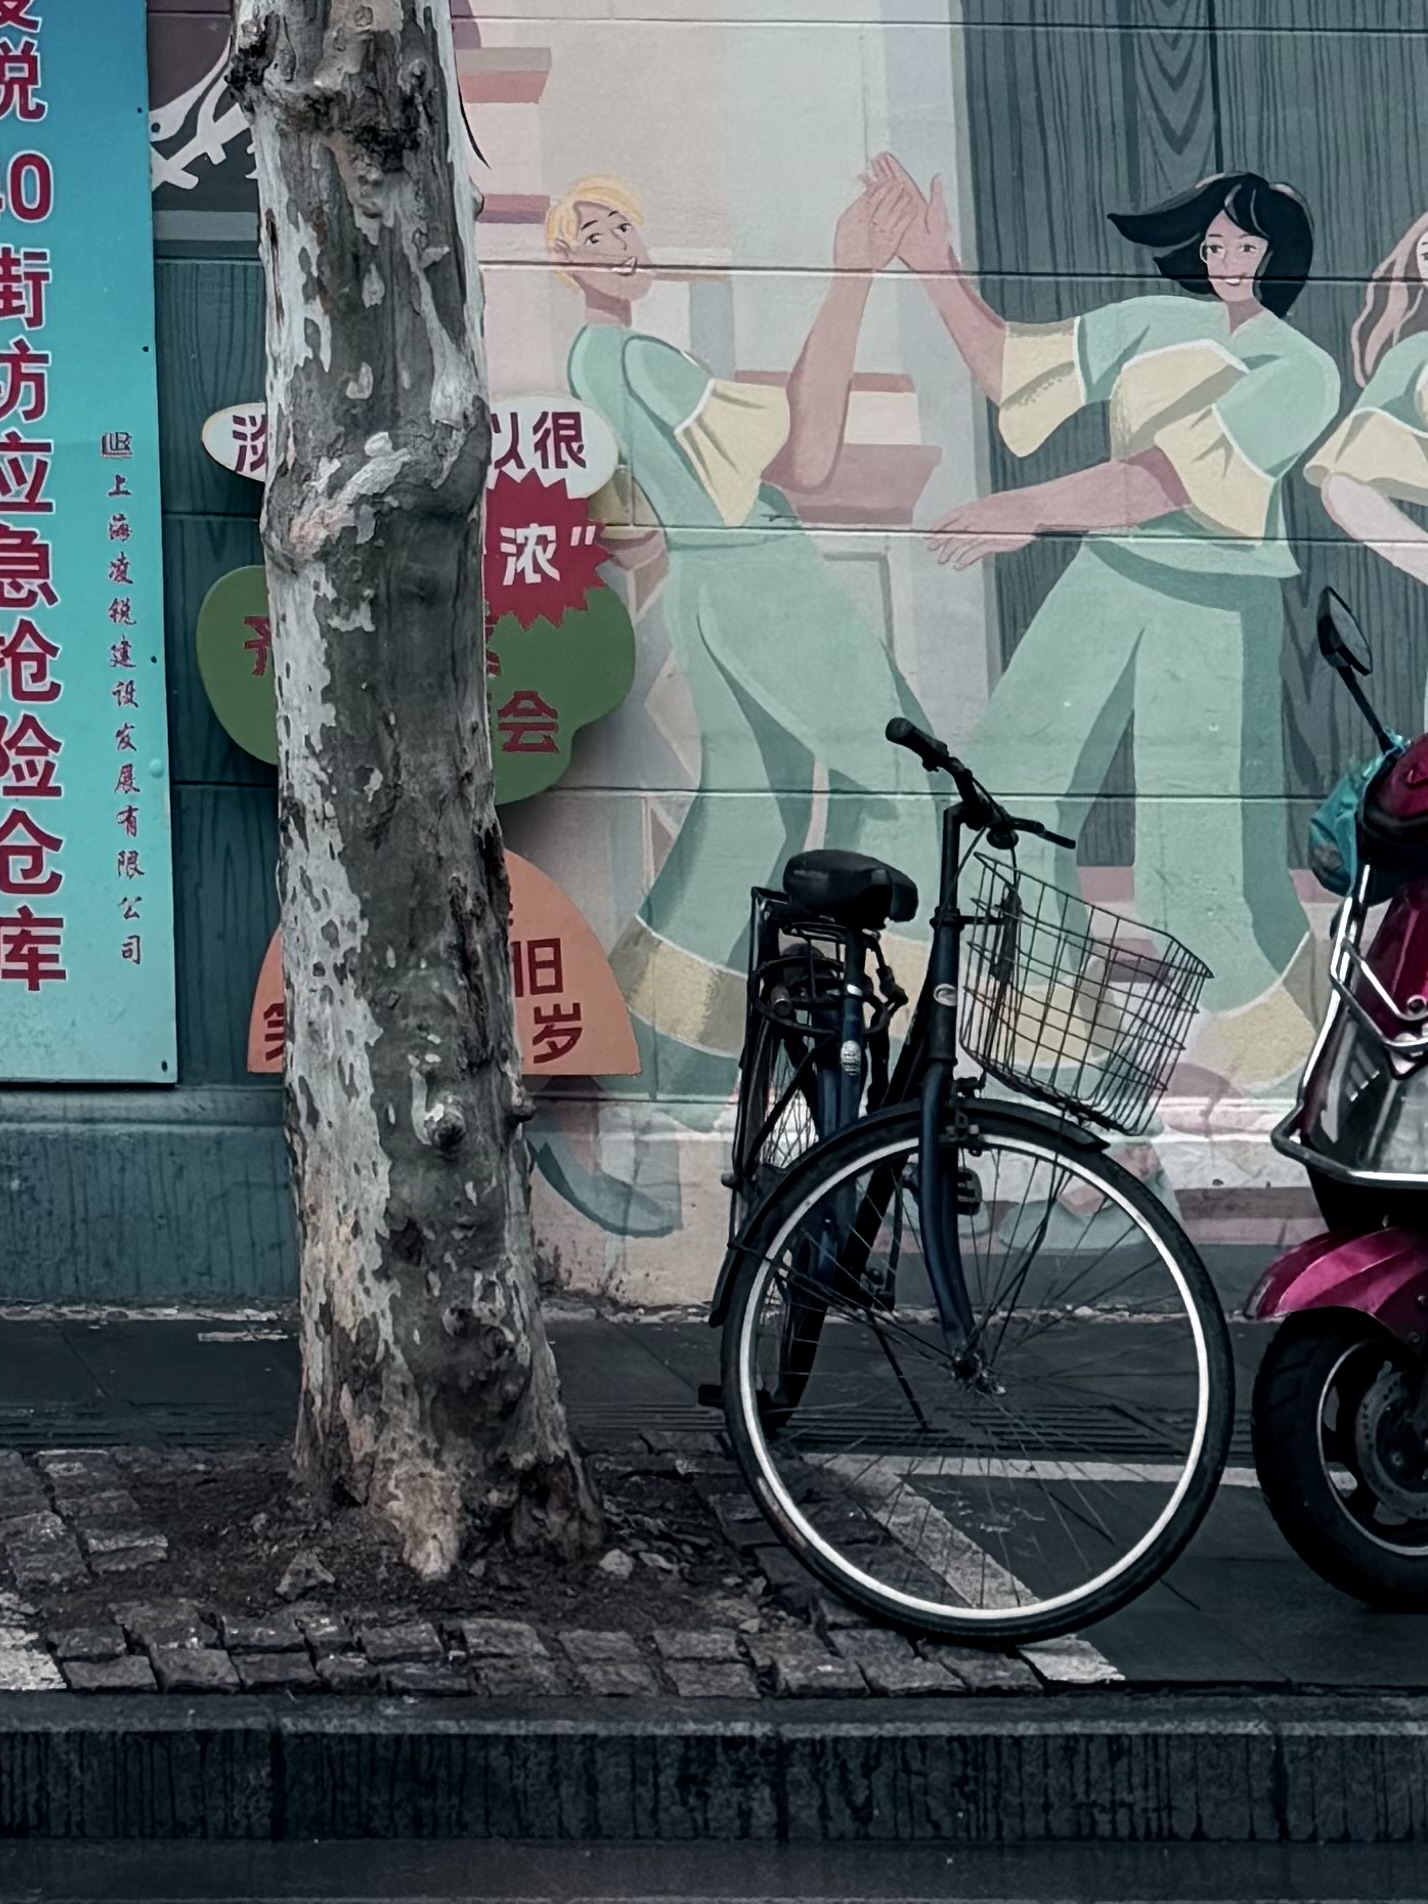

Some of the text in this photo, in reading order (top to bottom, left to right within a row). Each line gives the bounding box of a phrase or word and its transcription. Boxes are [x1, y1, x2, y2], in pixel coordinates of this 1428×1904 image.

[106, 474, 145, 966] 上海凌锐建设发展有限公司
[532, 1002, 583, 1065] 岁
